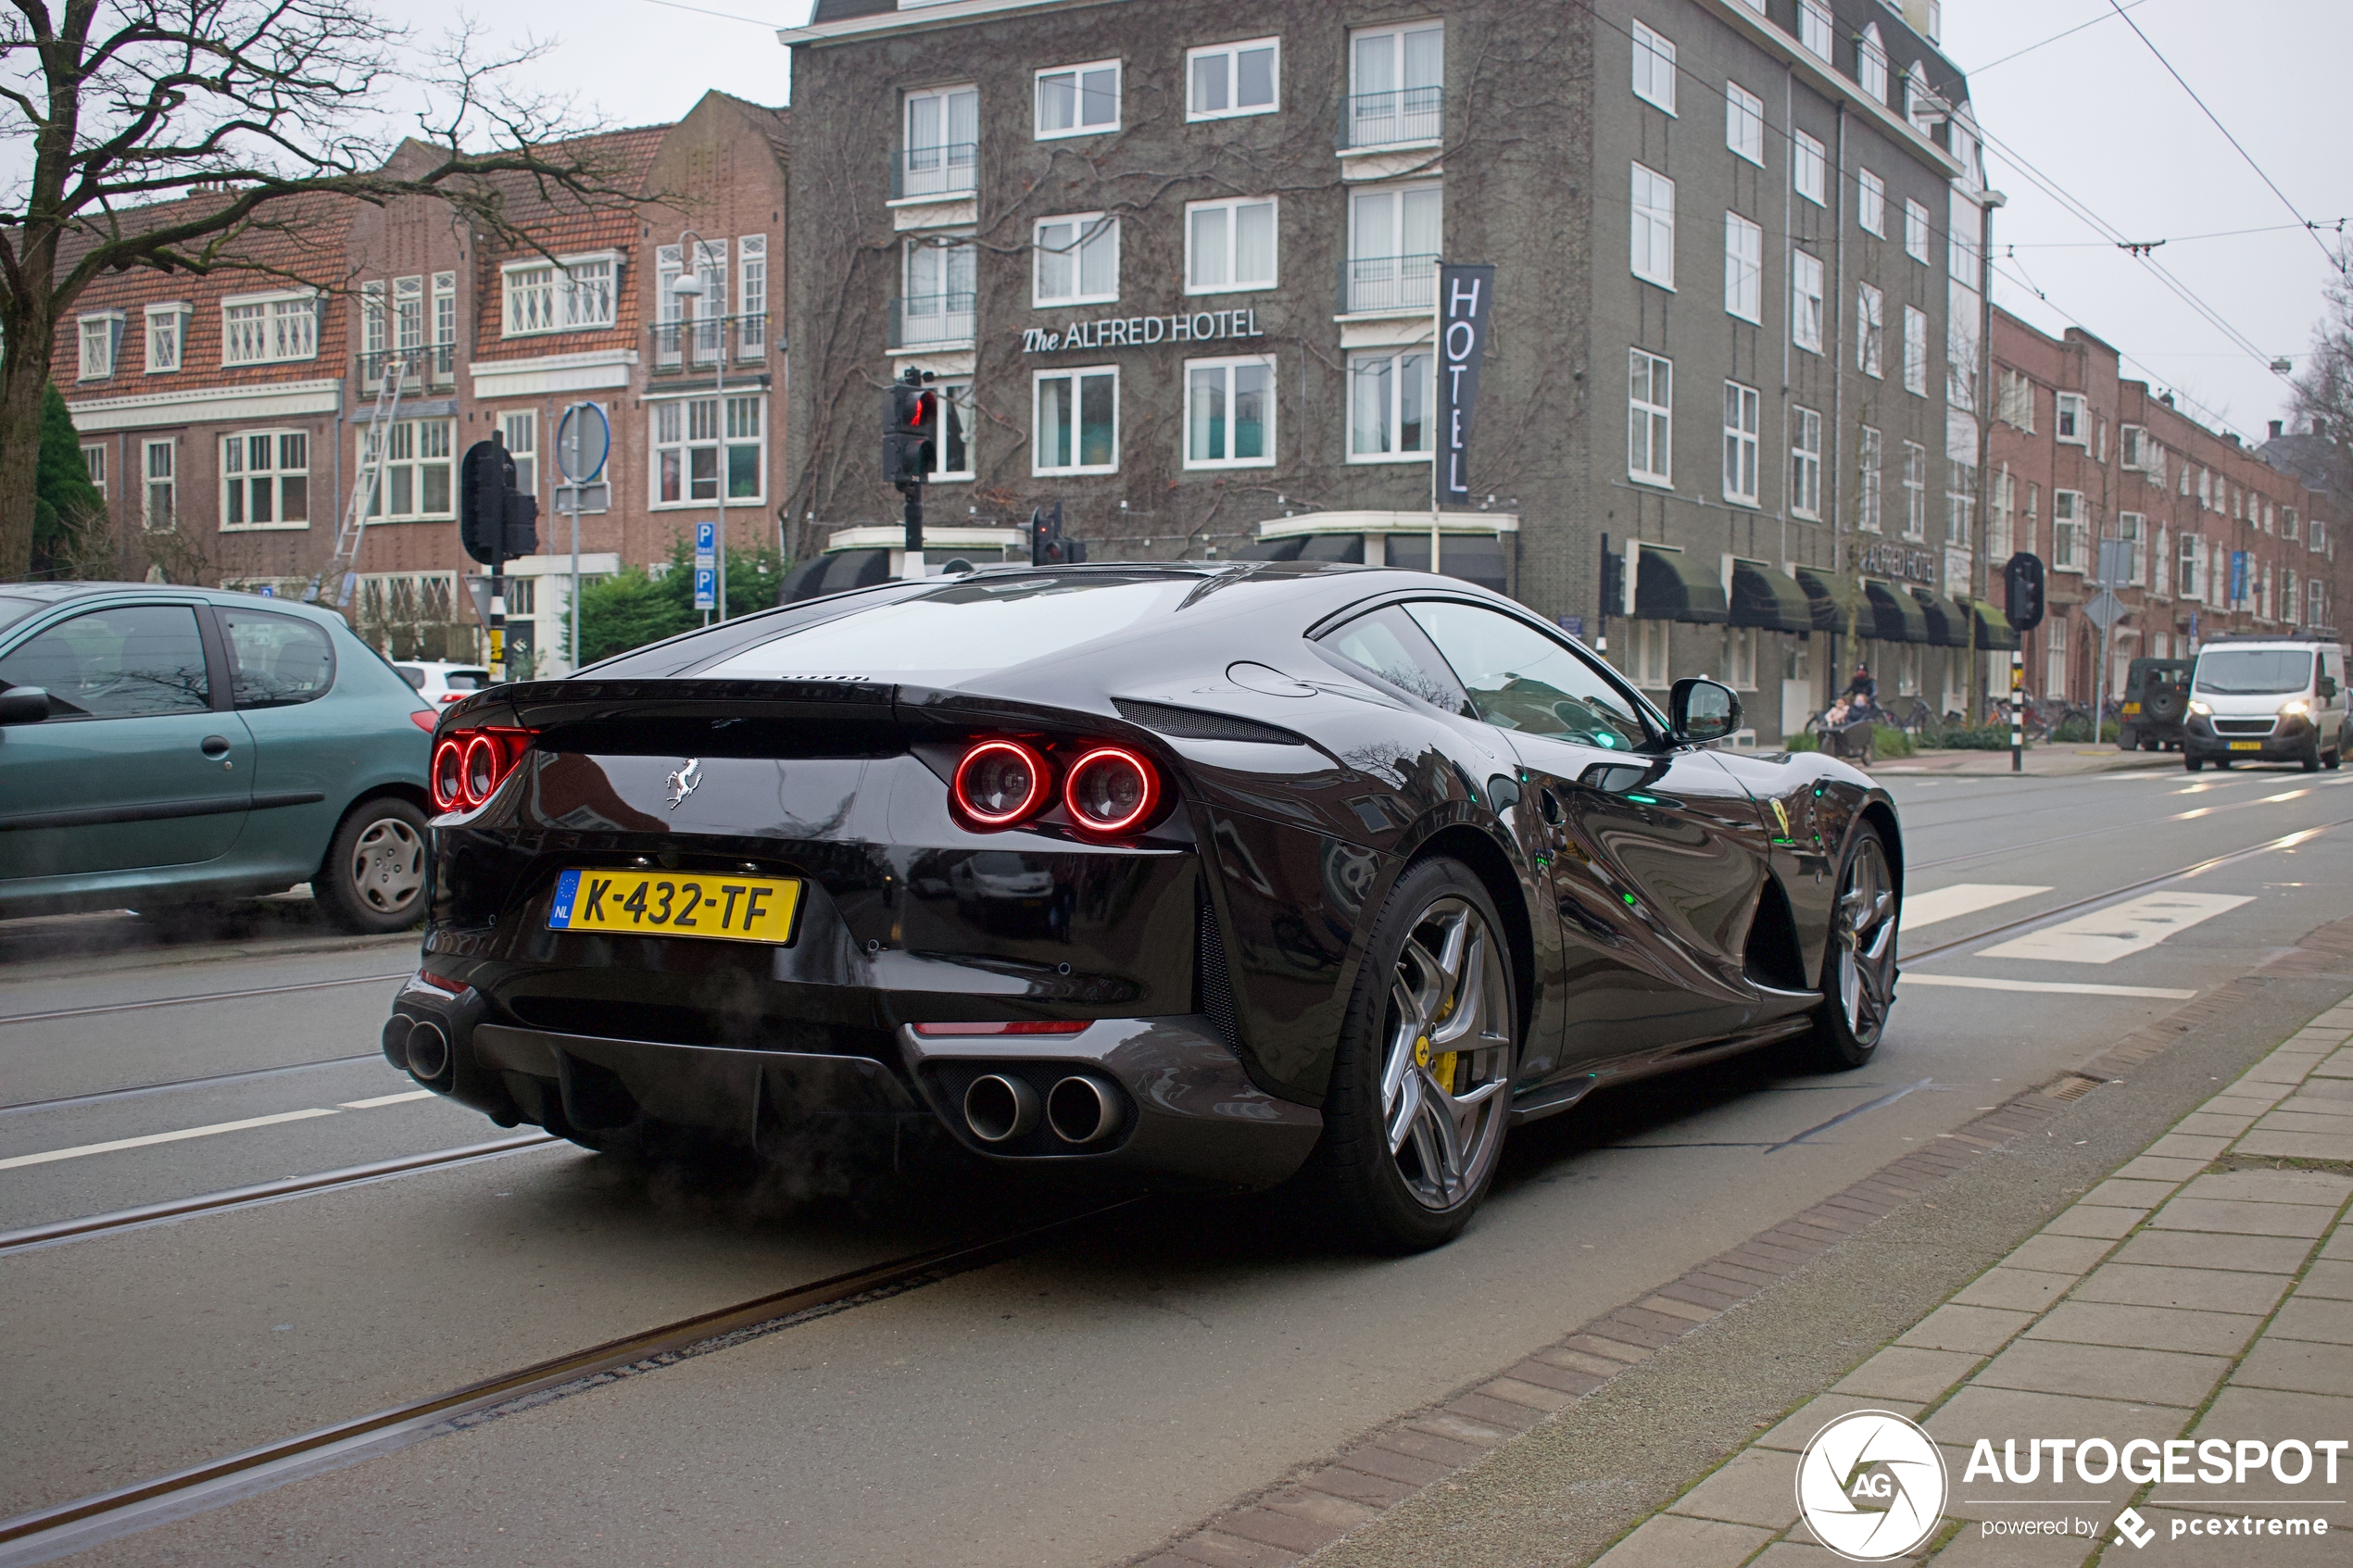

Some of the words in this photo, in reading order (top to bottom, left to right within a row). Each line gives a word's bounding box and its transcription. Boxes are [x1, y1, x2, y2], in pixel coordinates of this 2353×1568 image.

[1022, 328, 1059, 353] The
[1065, 316, 1164, 349] ALFRED
[1172, 308, 1264, 341] HOTEL
[1446, 278, 1480, 493] HOTEL
[699, 525, 711, 543] P
[698, 571, 711, 589] P
[555, 906, 569, 919] NL
[584, 879, 773, 931] K-432-TF
